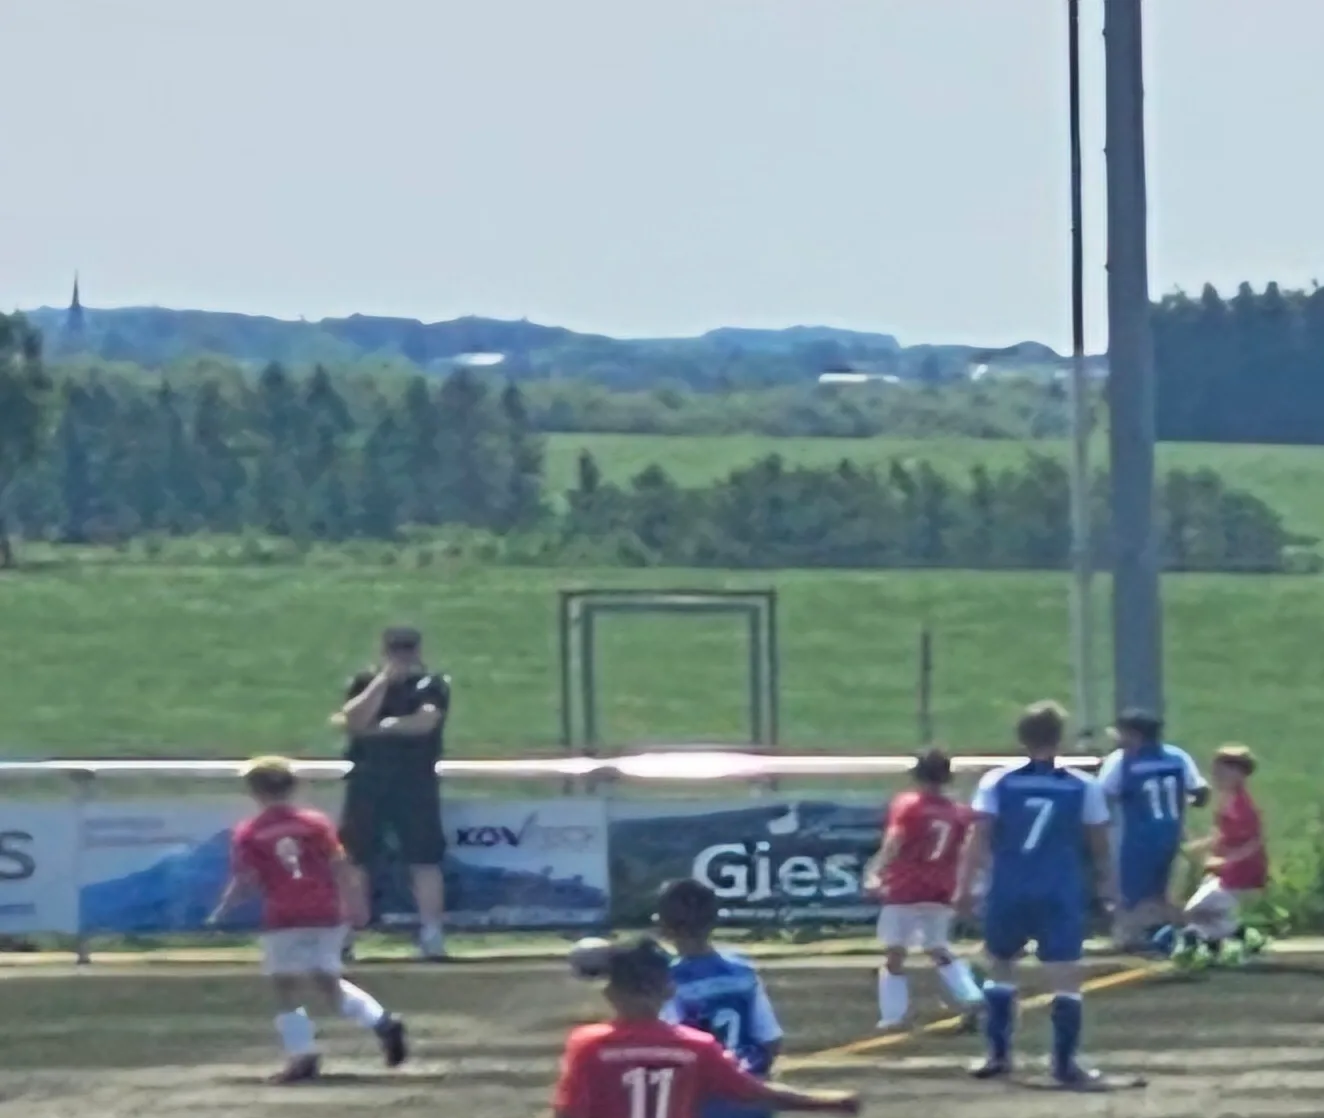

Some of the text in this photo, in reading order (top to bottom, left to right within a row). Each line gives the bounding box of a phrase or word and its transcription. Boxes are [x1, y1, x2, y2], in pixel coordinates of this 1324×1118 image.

[1143, 775, 1179, 821] 11
[928, 820, 952, 860] 7
[1018, 798, 1055, 852] 7
